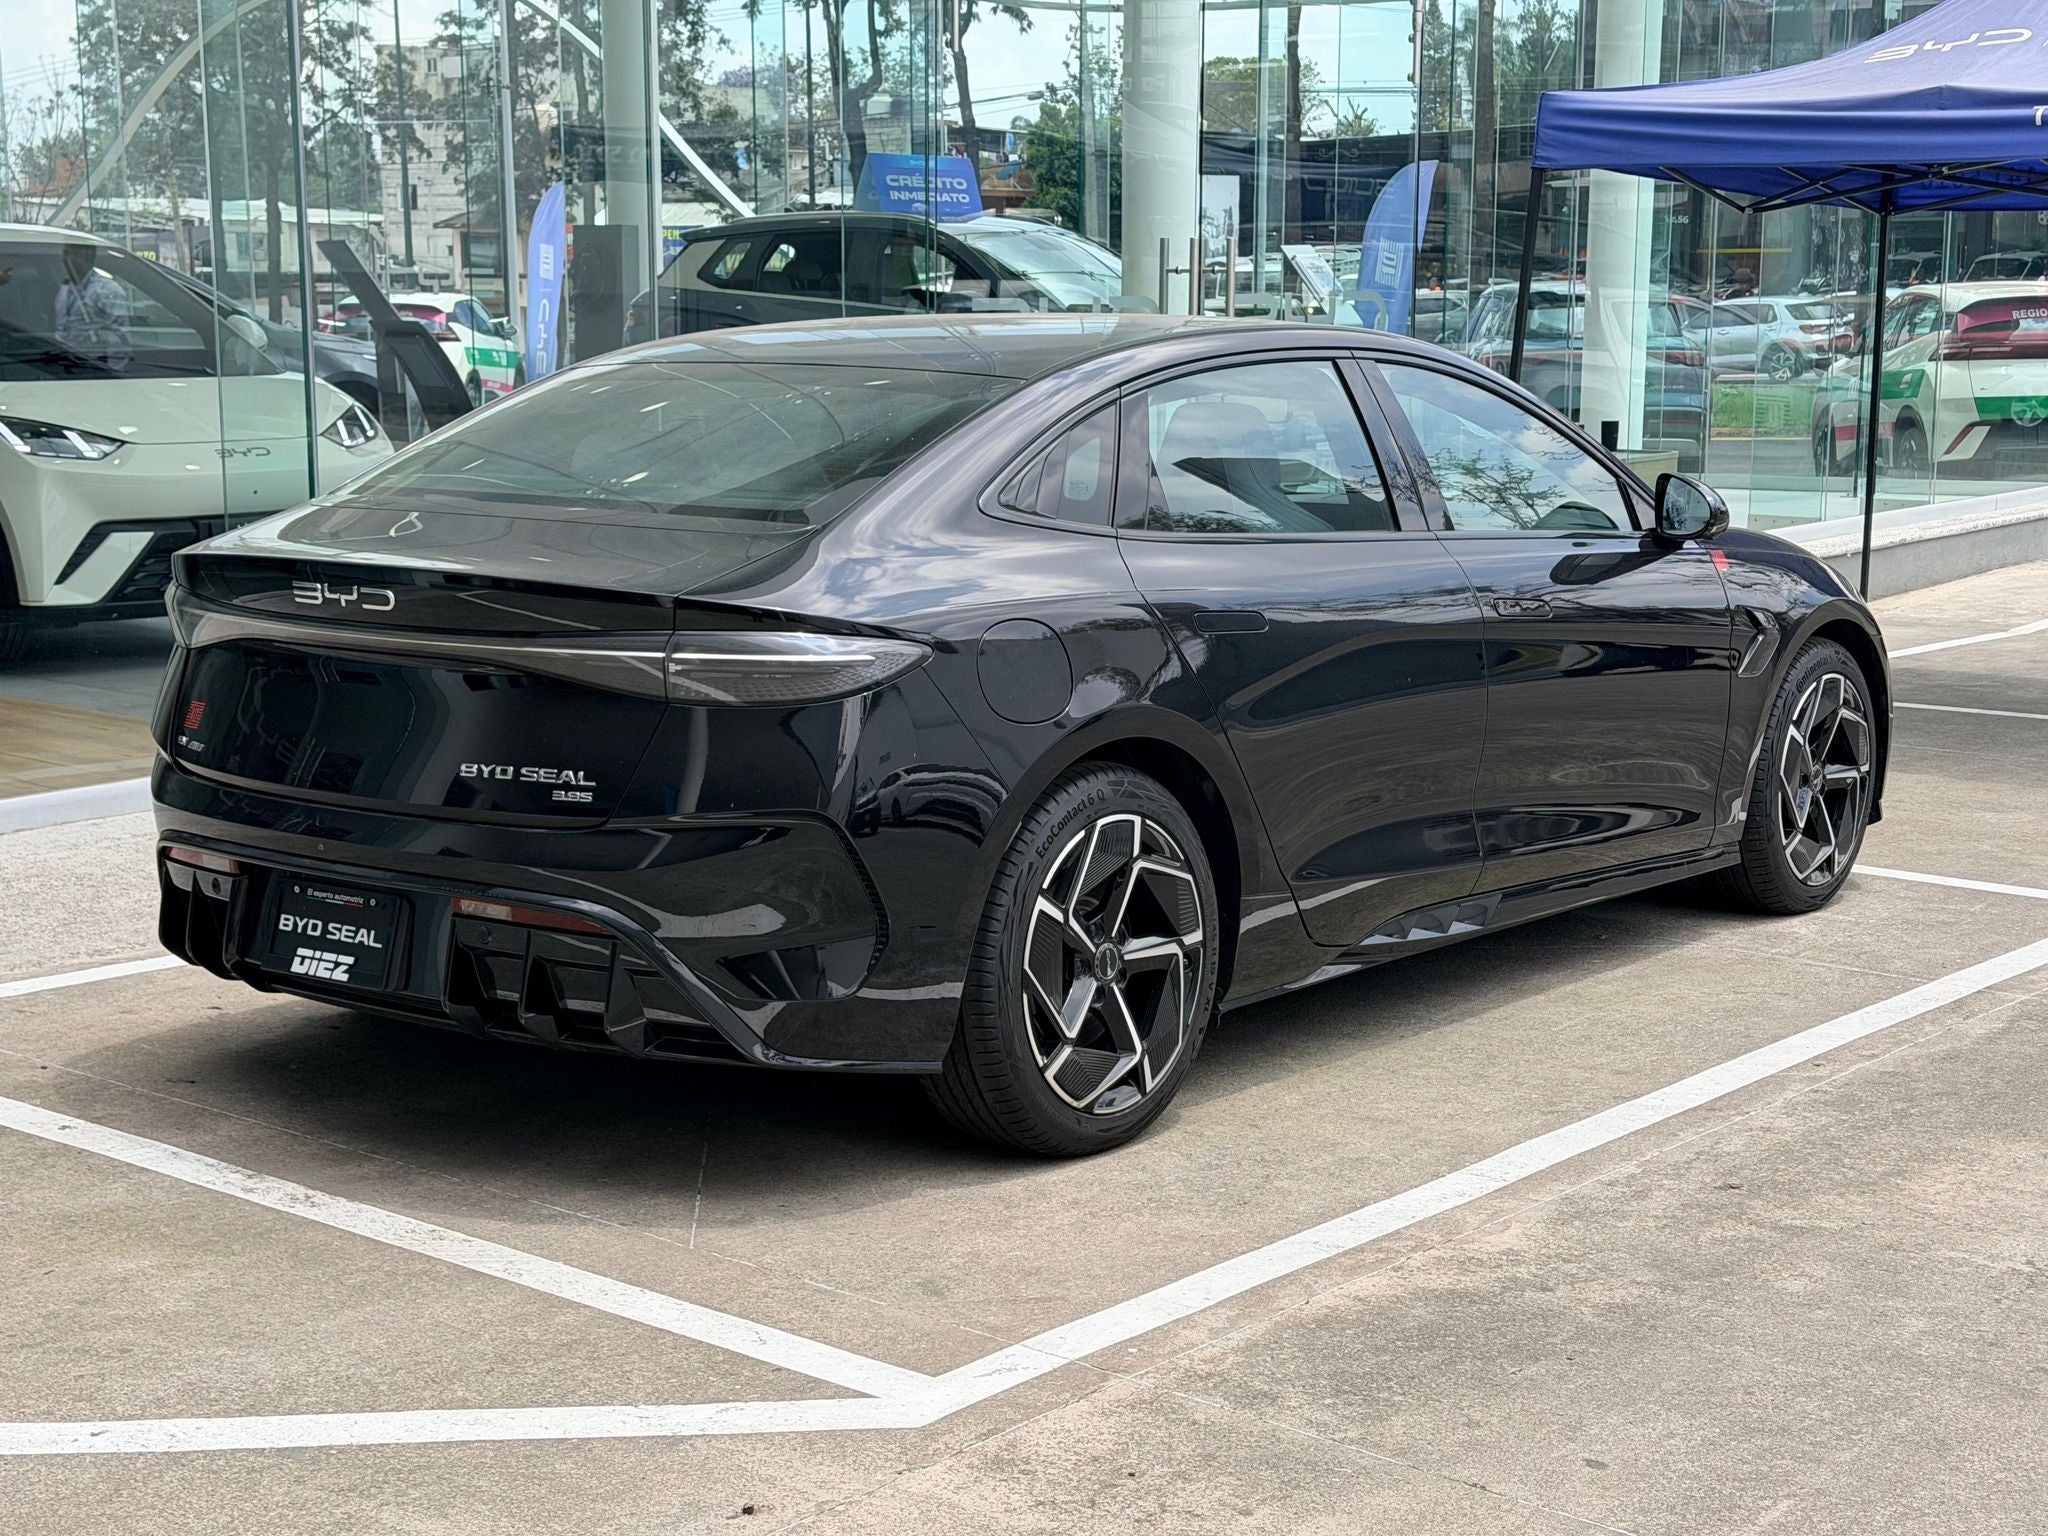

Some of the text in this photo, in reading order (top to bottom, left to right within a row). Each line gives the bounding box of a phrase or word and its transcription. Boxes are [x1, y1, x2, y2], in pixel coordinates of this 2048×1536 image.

[1864, 28, 2033, 64] BYD
[885, 172, 968, 190] CRÉDITO
[889, 190, 970, 203] INMEDIATO
[2012, 308, 2048, 320] REGIO
[214, 446, 271, 458] BYD
[291, 580, 396, 612] BYD
[459, 763, 597, 787] BYD SEAL
[1034, 788, 1107, 859] EcoContact 6 Q
[306, 887, 364, 905] El experto automotriz
[278, 913, 383, 949] BYD SEAL
